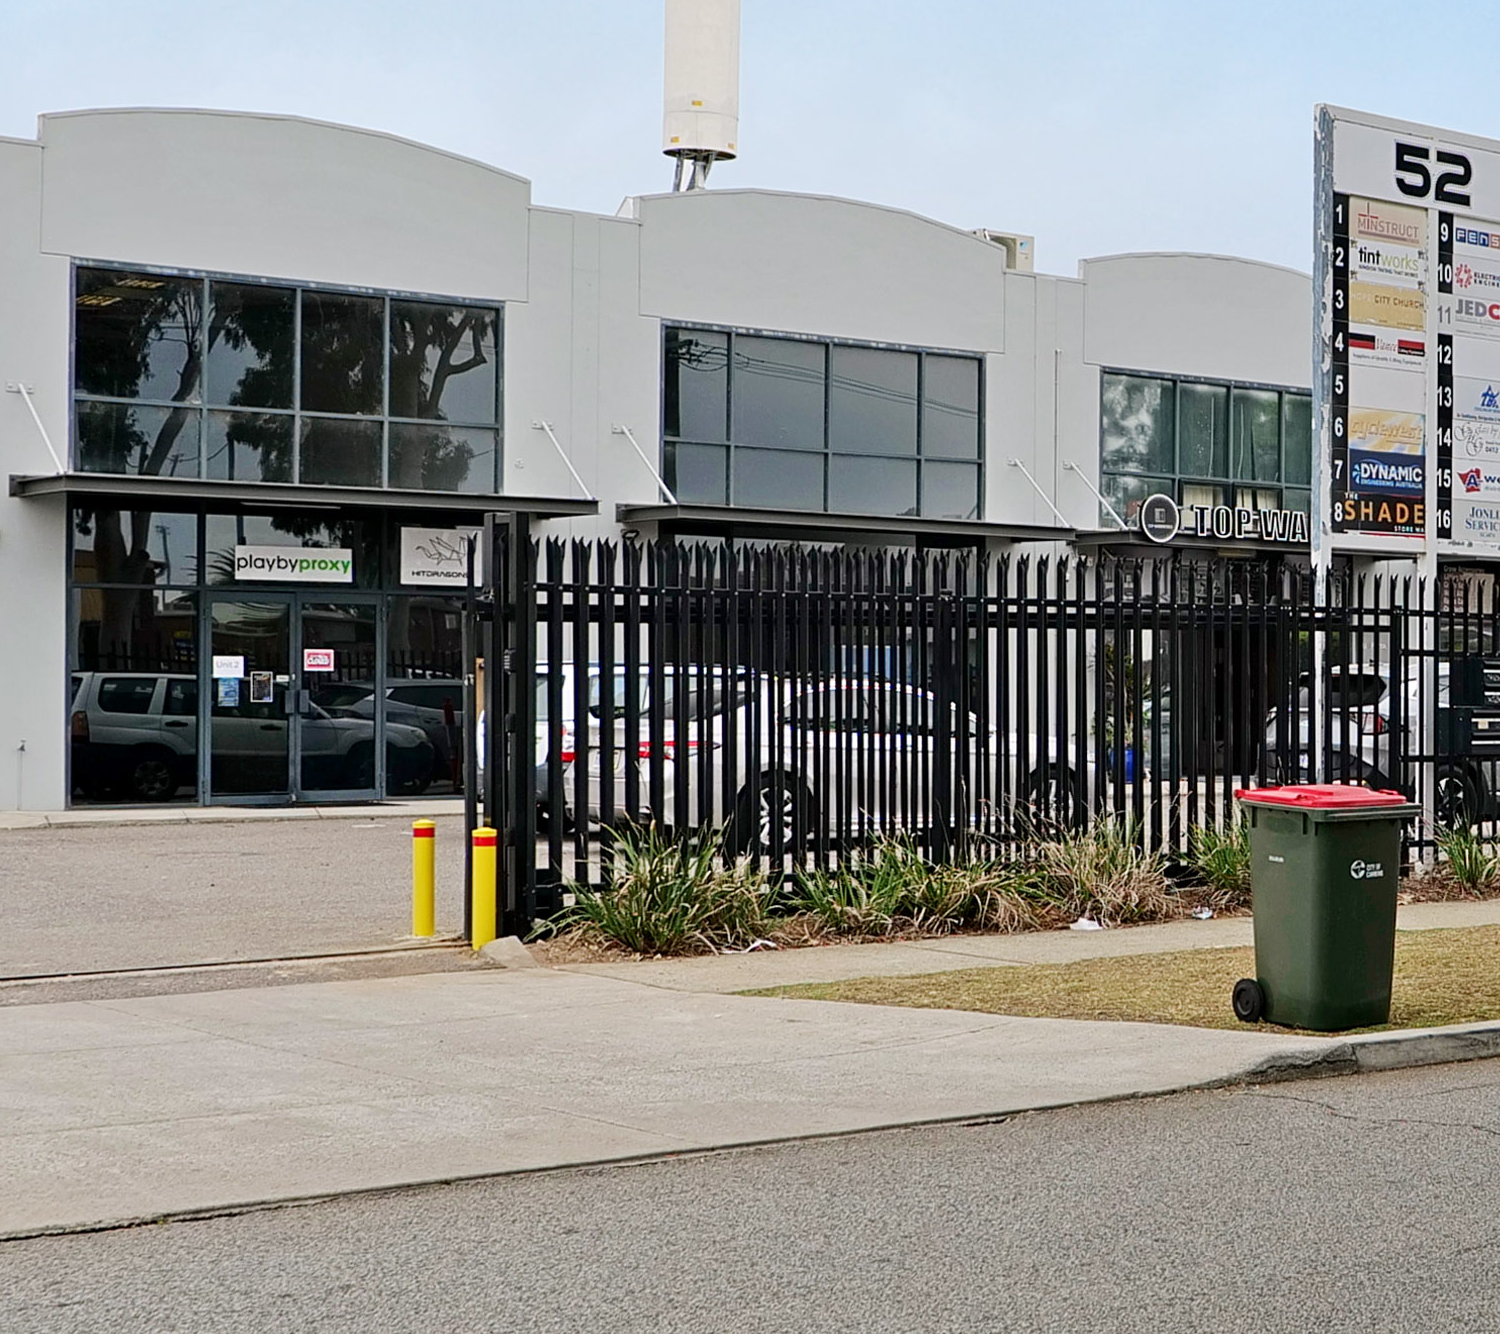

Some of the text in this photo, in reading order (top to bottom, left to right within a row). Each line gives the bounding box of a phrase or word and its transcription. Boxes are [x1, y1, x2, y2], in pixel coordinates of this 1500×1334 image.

[1395, 141, 1472, 207] 52
[1335, 203, 1343, 224] 1
[1357, 216, 1420, 239] MINSTRUCT
[1440, 222, 1449, 242] 9
[1335, 246, 1344, 267] 2
[1358, 247, 1419, 272] tintworks
[1437, 263, 1452, 283] 10
[1335, 289, 1344, 309] 3
[1374, 295, 1390, 304] CITY
[1393, 298, 1424, 309] CHURCH
[1437, 305, 1451, 324] 11
[1335, 332, 1344, 352] 4
[1437, 344, 1452, 364] 12
[1334, 374, 1344, 395] 5
[1437, 386, 1452, 407] 13
[1334, 417, 1344, 437] 6
[1437, 427, 1452, 447] 14
[1334, 460, 1343, 479] 7
[1360, 463, 1423, 482] DYNAMIC
[1437, 468, 1451, 488] 15
[1360, 479, 1423, 489] ENGINEERING AUSTRALIA
[1344, 492, 1358, 500] THE
[1194, 505, 1252, 538] TOP
[1334, 502, 1343, 522] 8
[1344, 500, 1425, 524] SHADE
[1437, 509, 1451, 529] 16
[237, 554, 351, 574] playbyproxy
[216, 660, 233, 669] Unit
